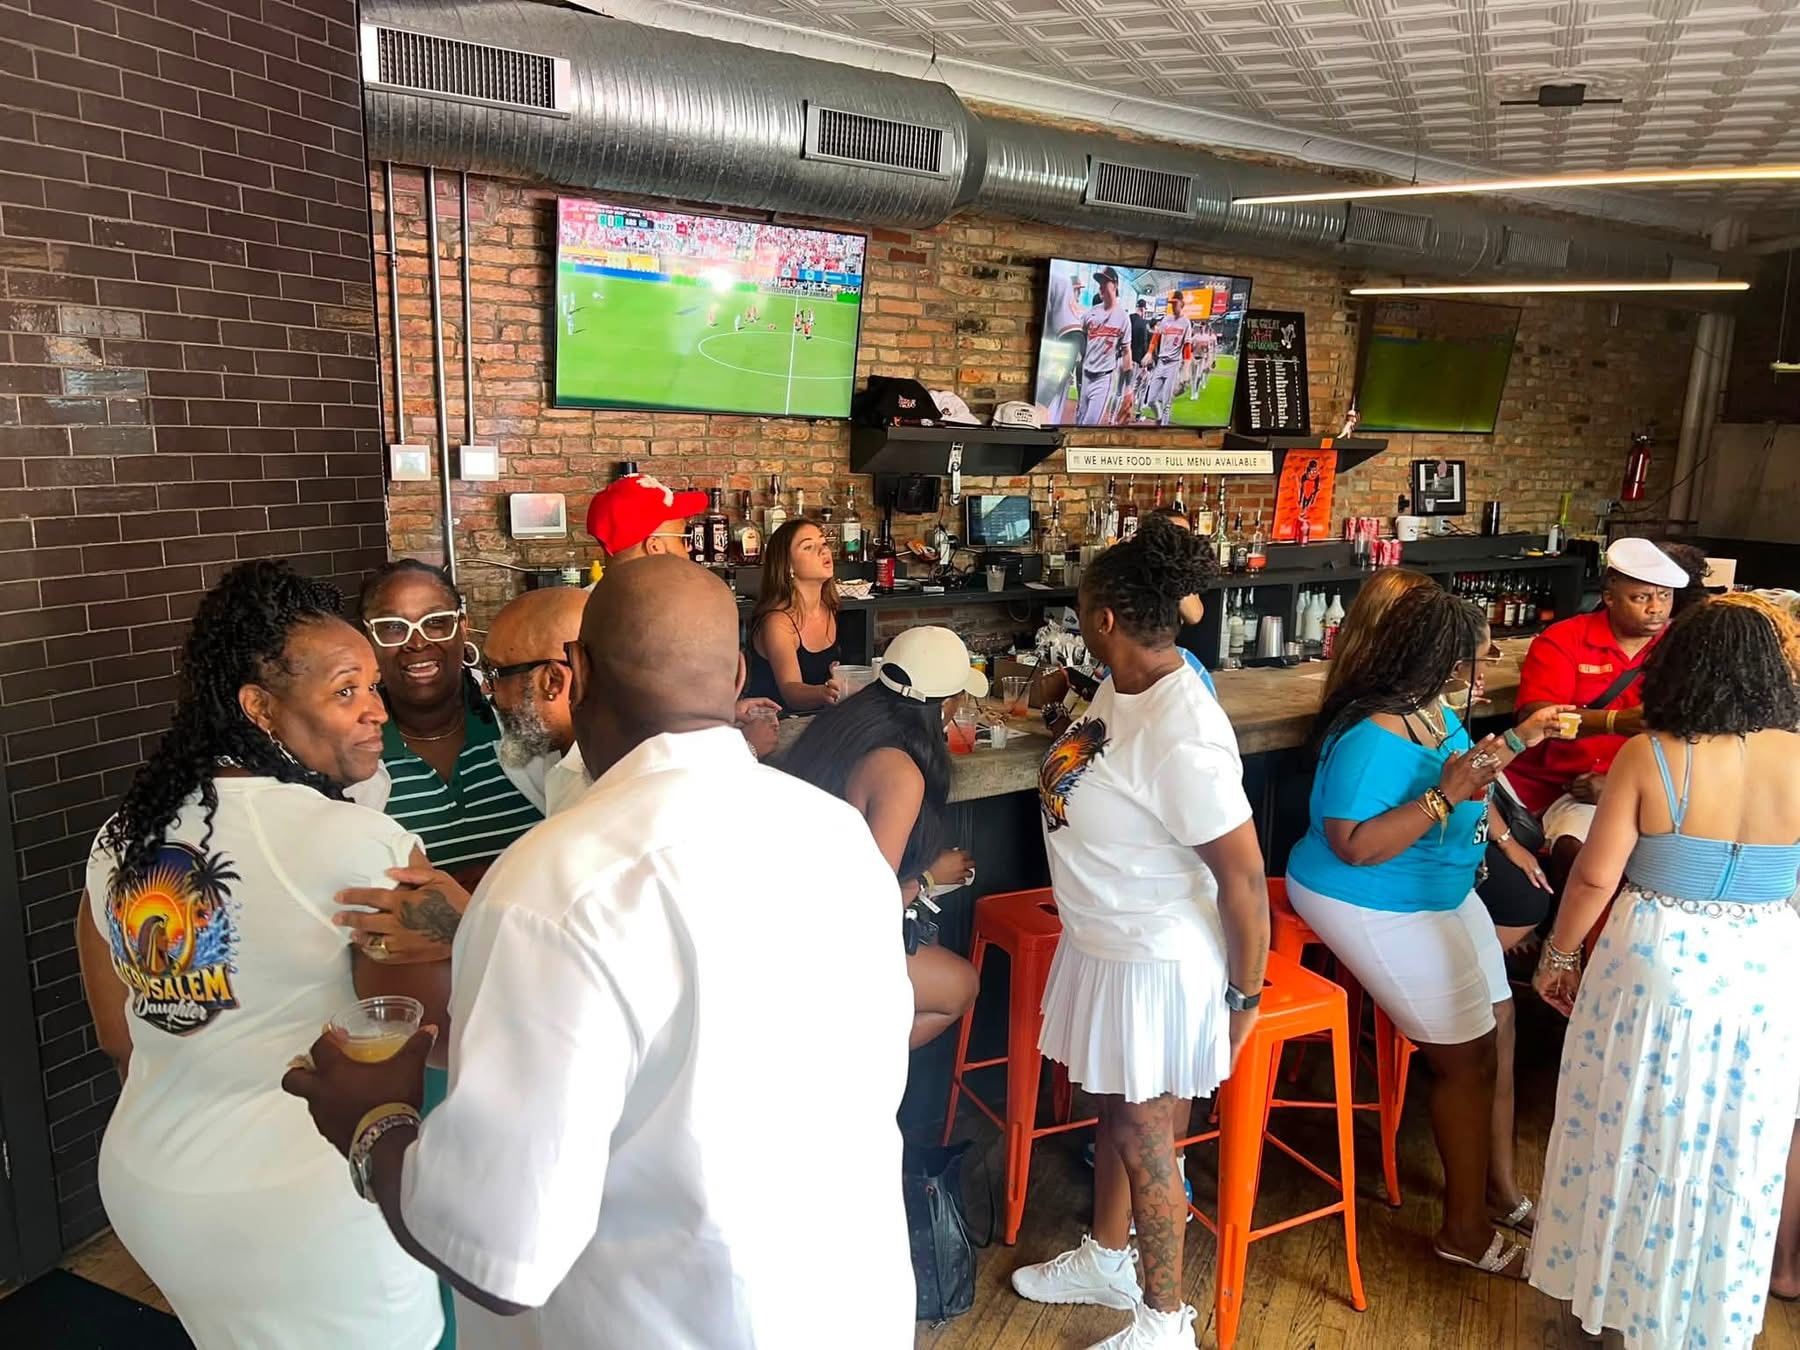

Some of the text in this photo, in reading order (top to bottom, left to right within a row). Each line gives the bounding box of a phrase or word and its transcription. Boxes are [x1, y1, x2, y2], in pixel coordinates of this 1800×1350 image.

[1083, 455, 1257, 467] WE HAVE FOOD FULL MENU AVAILABLE
[134, 993, 208, 1022] Daughter
